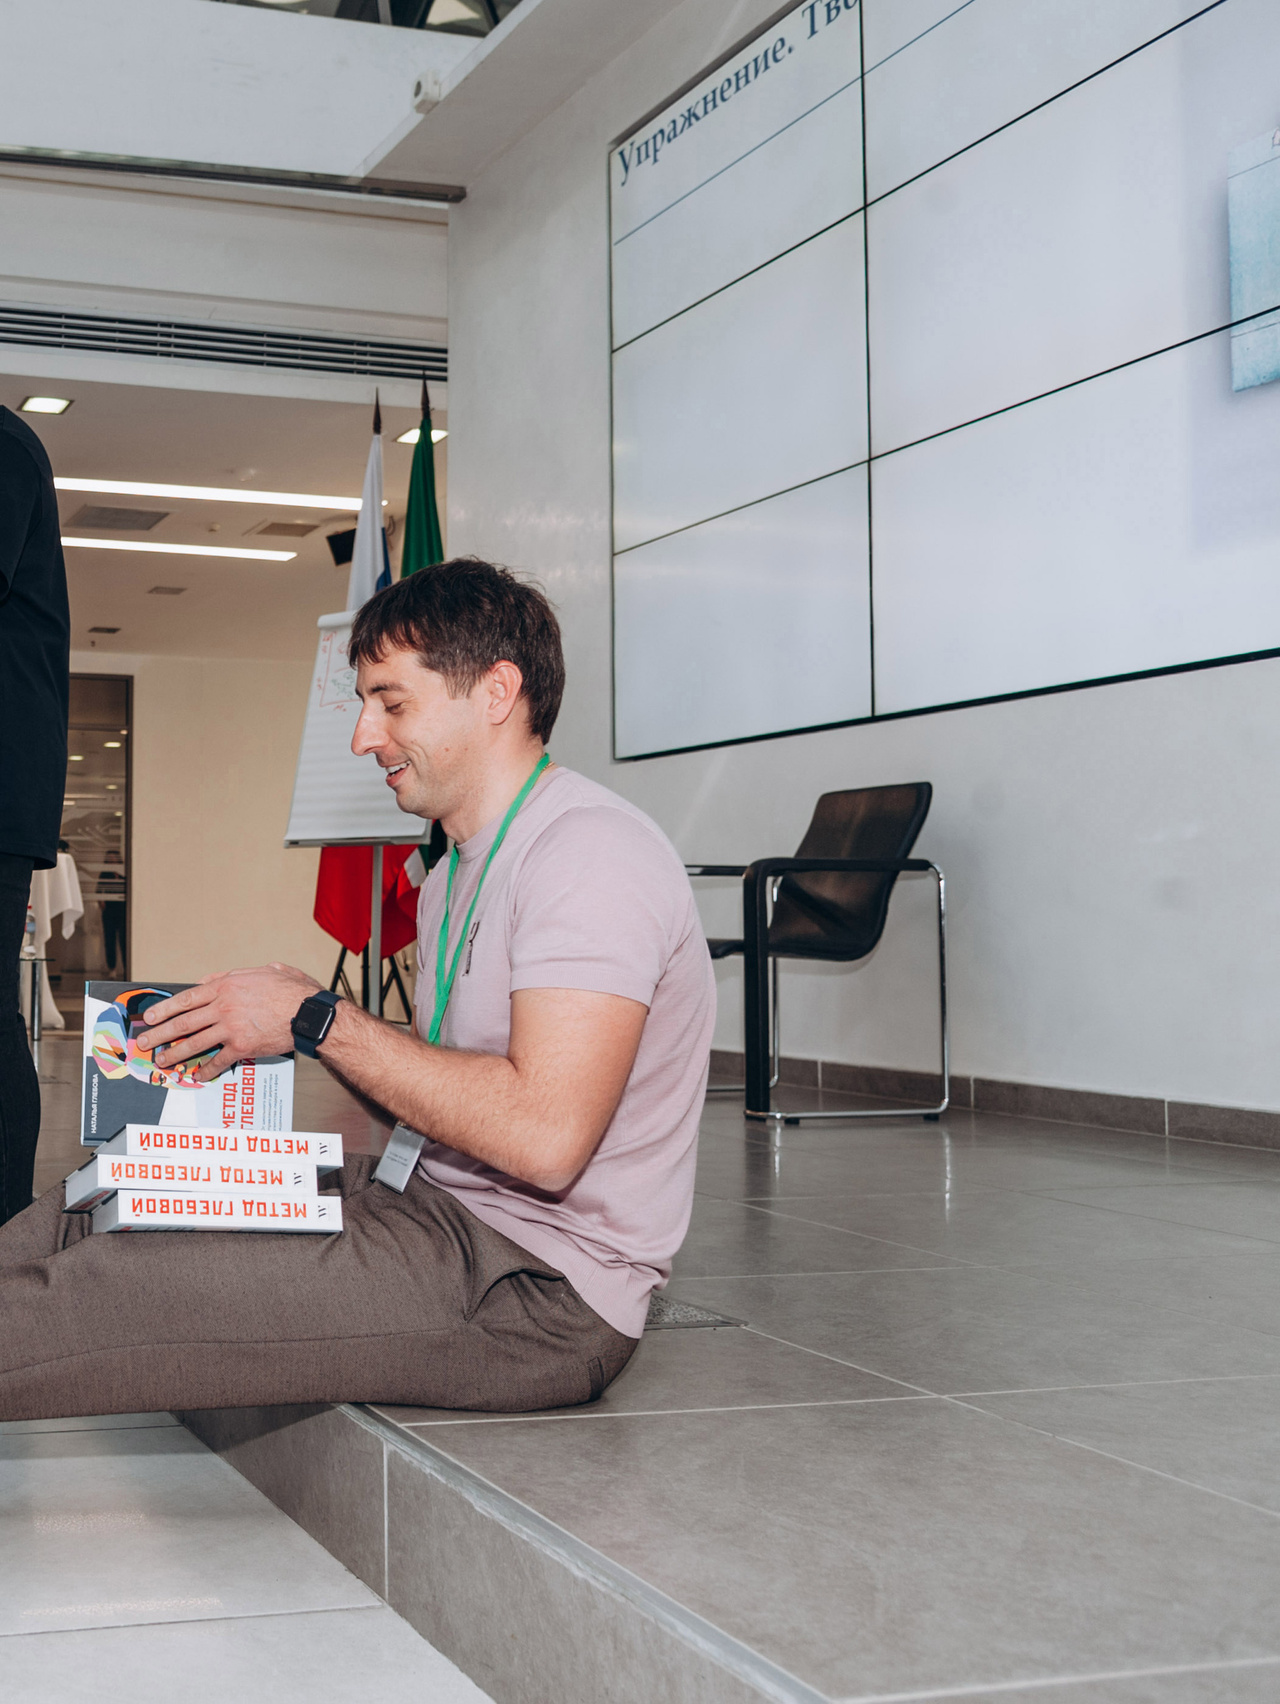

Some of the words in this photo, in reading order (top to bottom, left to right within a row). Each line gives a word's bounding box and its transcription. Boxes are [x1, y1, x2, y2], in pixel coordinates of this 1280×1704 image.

[618, 37, 795, 187] Упражнение.
[139, 1132, 238, 1152] ГЛЕБОВОЙ
[246, 1135, 309, 1155] МЕТОД
[111, 1162, 211, 1182] ГЛЕБОВОЙ
[220, 1165, 283, 1186] МЕТОД
[132, 1198, 233, 1217] ГЛЕБОВОЙ
[242, 1199, 307, 1218] МЕТОД
